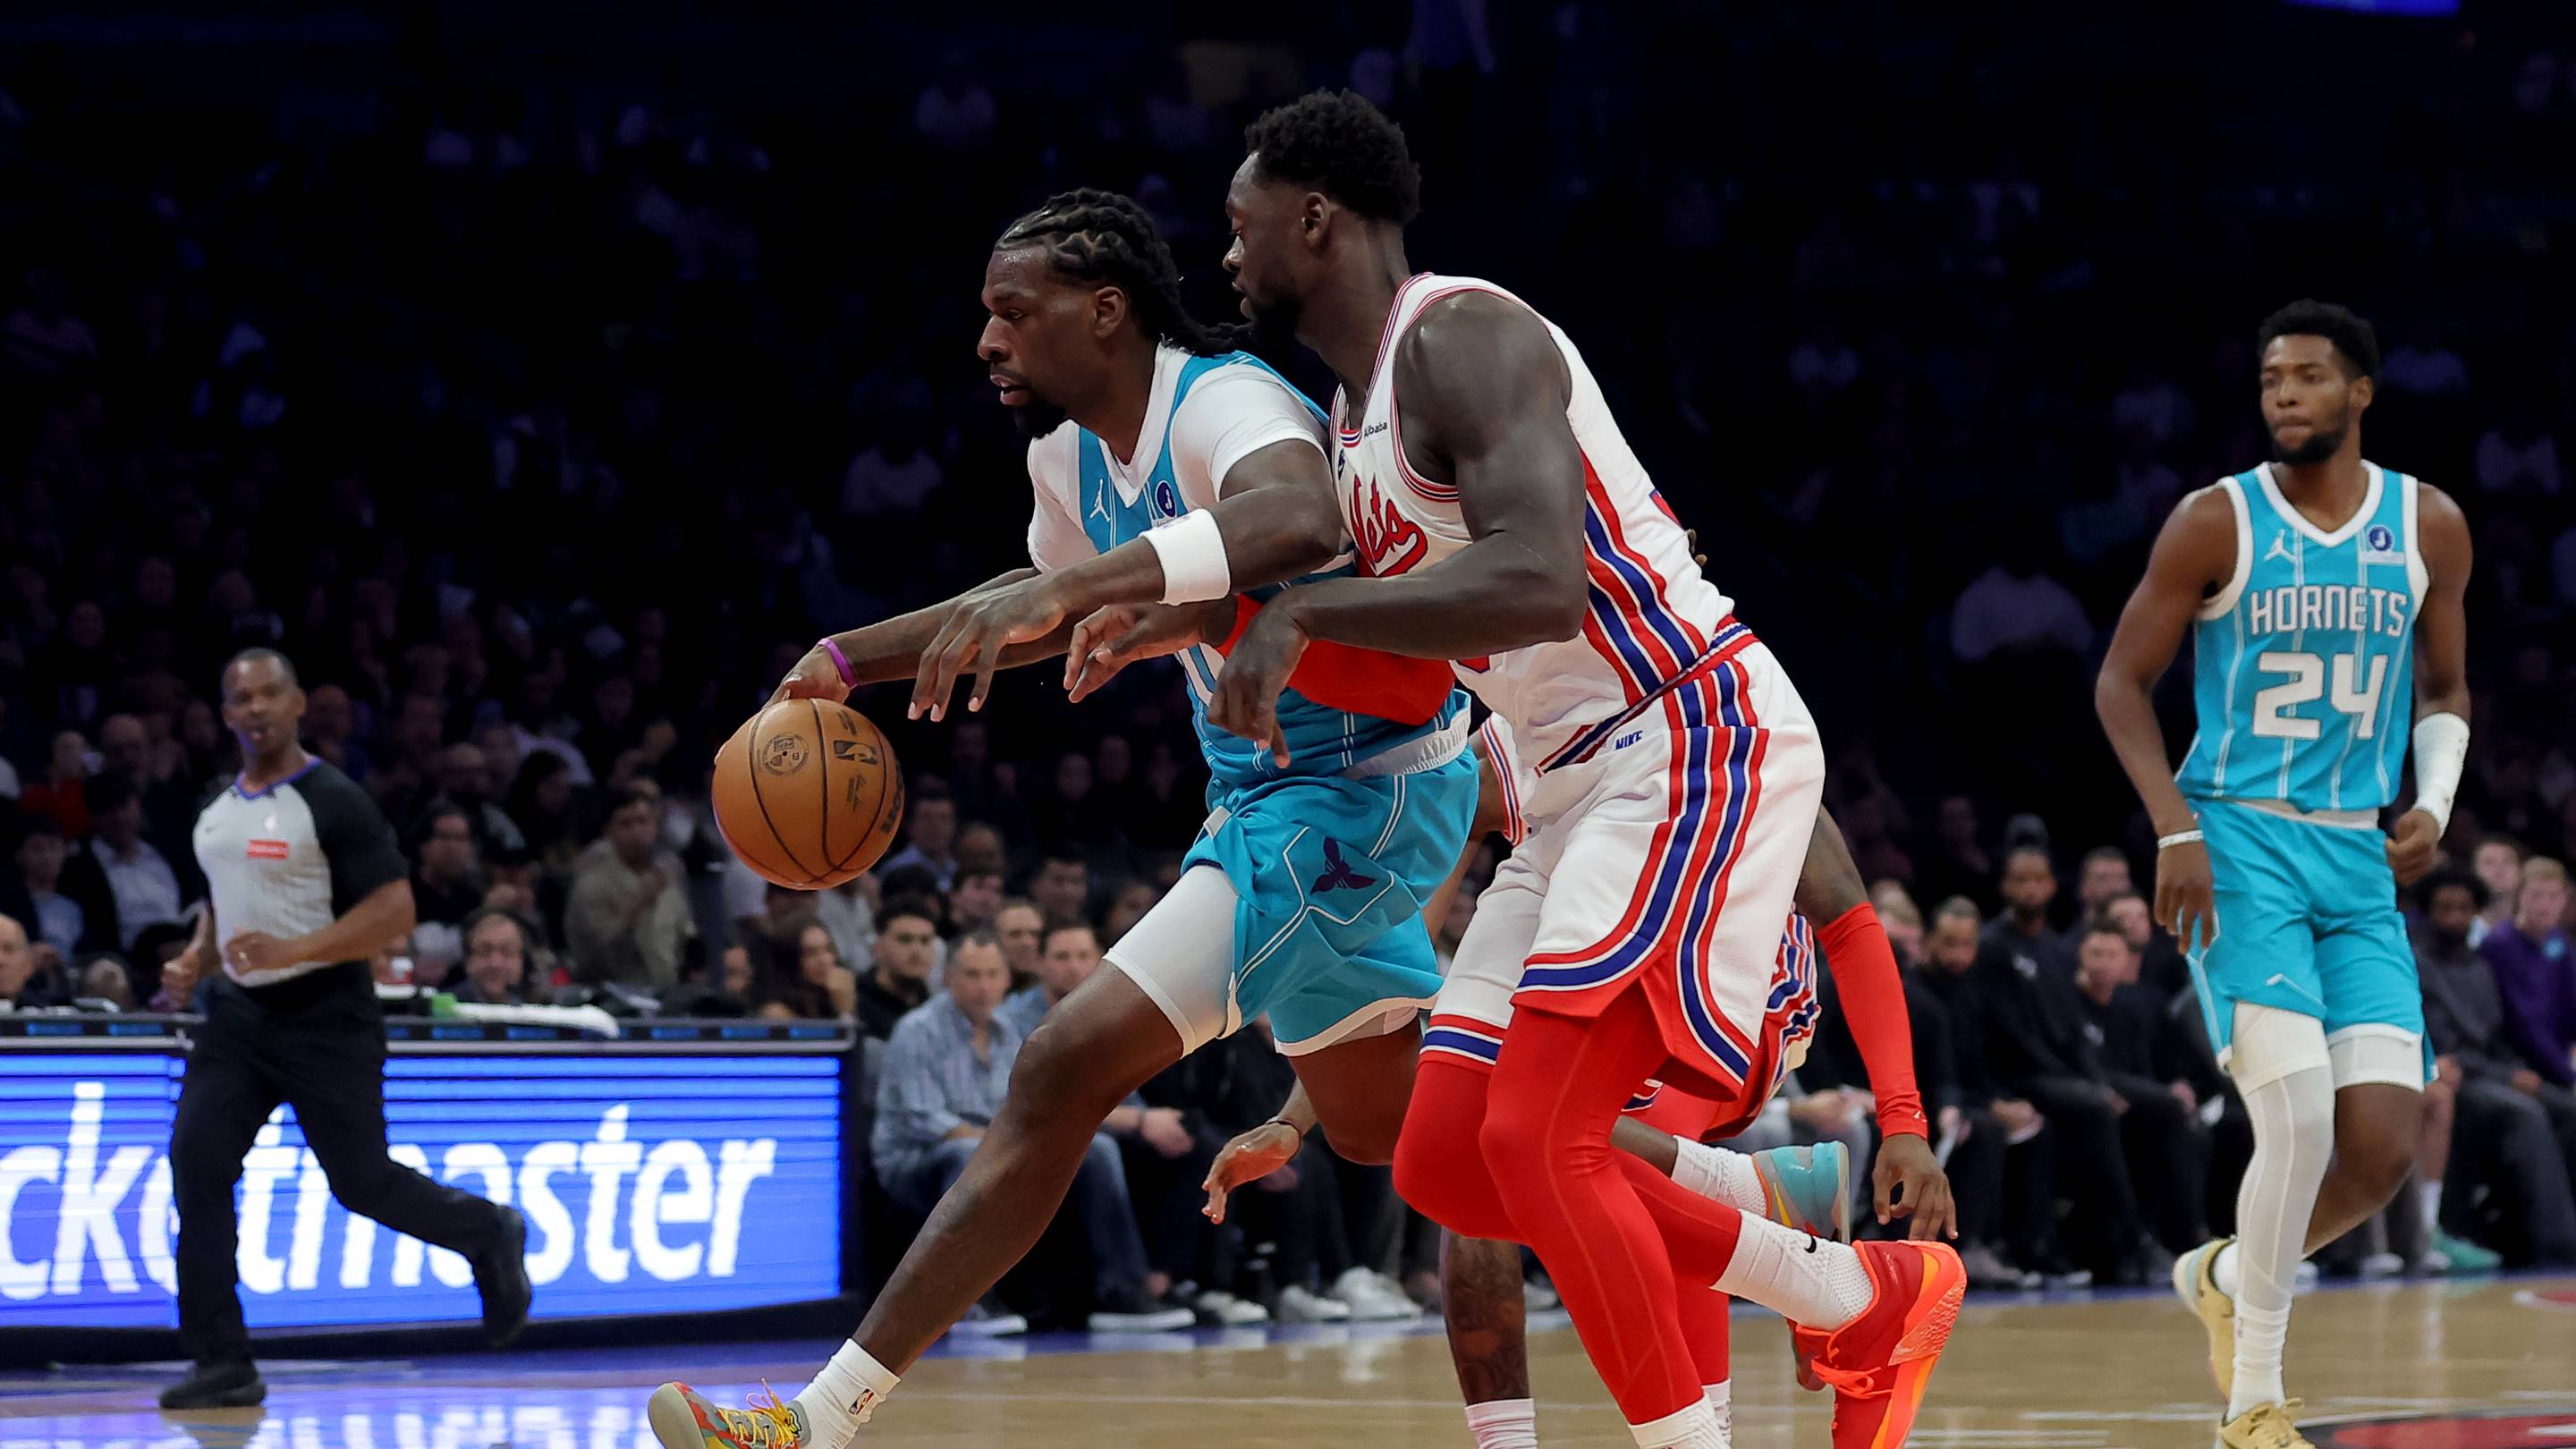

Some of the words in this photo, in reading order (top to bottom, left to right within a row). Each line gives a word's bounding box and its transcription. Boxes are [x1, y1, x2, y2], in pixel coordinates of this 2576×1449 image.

[2250, 585, 2408, 638] HORNETS
[2253, 652, 2389, 741] 24
[1615, 730, 1643, 750] NIKE
